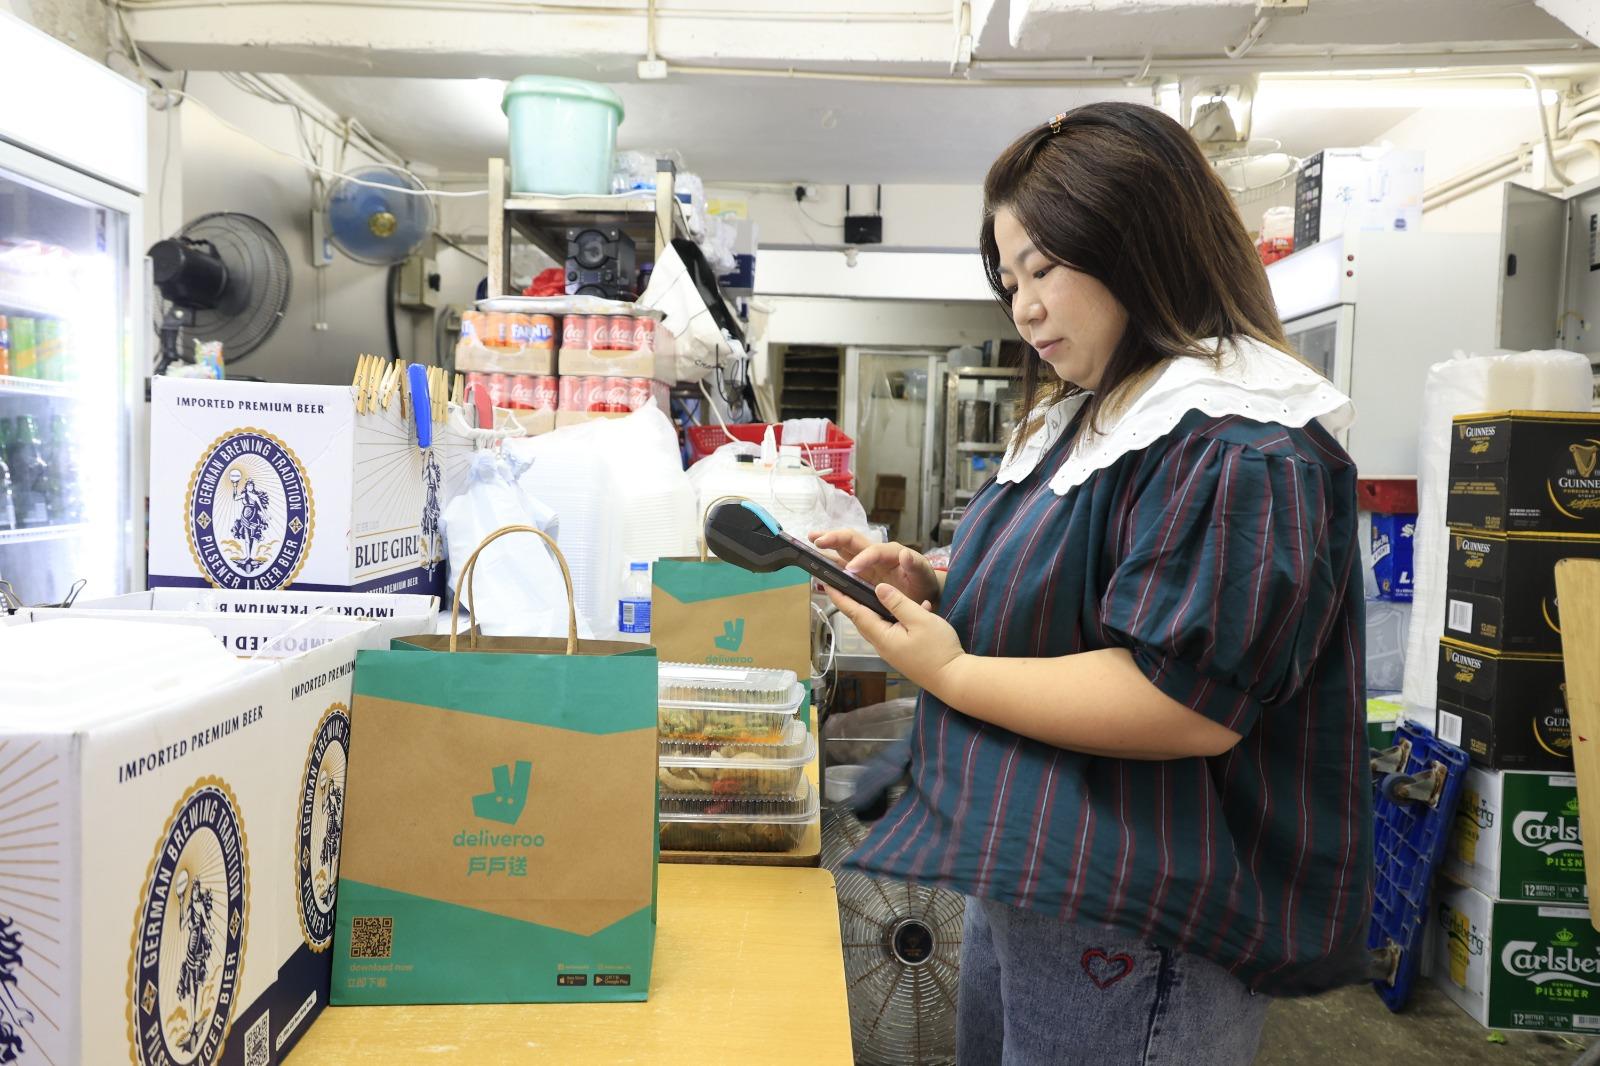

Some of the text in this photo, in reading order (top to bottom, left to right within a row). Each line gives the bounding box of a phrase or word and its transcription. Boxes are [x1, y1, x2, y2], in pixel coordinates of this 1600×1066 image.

[176, 396, 325, 414] IMPORTED PREMIUM BEER
[1466, 426, 1497, 438] GUINNESS
[198, 438, 302, 510] GERMAN BREWING TRADITION
[1558, 477, 1600, 488] GUINNE
[355, 534, 419, 568] BLUE GIRL
[1462, 539, 1492, 553] GUINNESS
[201, 535, 241, 589] PILSENER
[278, 539, 298, 568] BIER
[383, 579, 407, 594] PREMIUM
[407, 576, 418, 588] BEER
[1451, 652, 1483, 669] GUINNESS
[291, 673, 327, 701] IMPORTED
[1544, 715, 1571, 727] GUIN
[119, 705, 263, 784] IMPORTED PREMIUM BEER
[303, 721, 344, 837] GERMAN BREWING
[1512, 811, 1584, 847] Carls
[453, 829, 545, 848] deliveroo
[1546, 857, 1583, 867] PILSN
[143, 798, 241, 969] GERMAN BREWING TRADITION
[1524, 884, 1536, 897] 12
[304, 879, 326, 936] PILSENER
[219, 951, 237, 1005] BIER
[1535, 986, 1589, 998] PILSNER
[1513, 1013, 1524, 1025] 12
